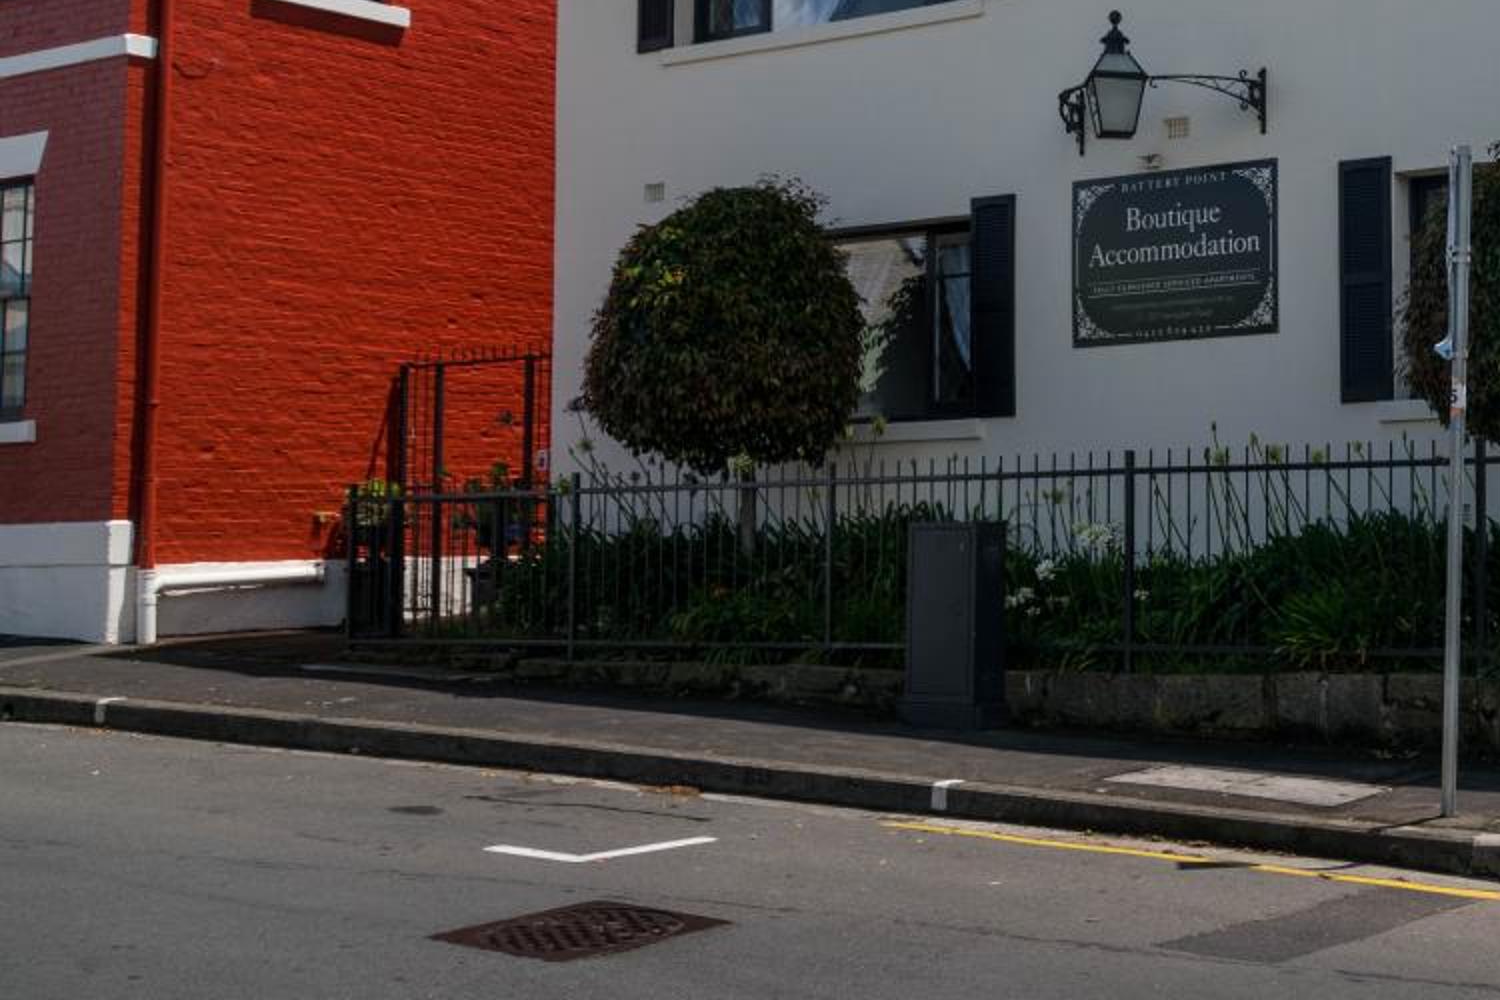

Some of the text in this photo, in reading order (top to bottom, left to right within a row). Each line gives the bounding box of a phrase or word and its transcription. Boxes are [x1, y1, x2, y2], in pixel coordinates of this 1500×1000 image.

[1121, 171, 1226, 194] BATTERY POINT
[1125, 201, 1222, 234] Boutique
[1088, 229, 1262, 268] Accommodation
